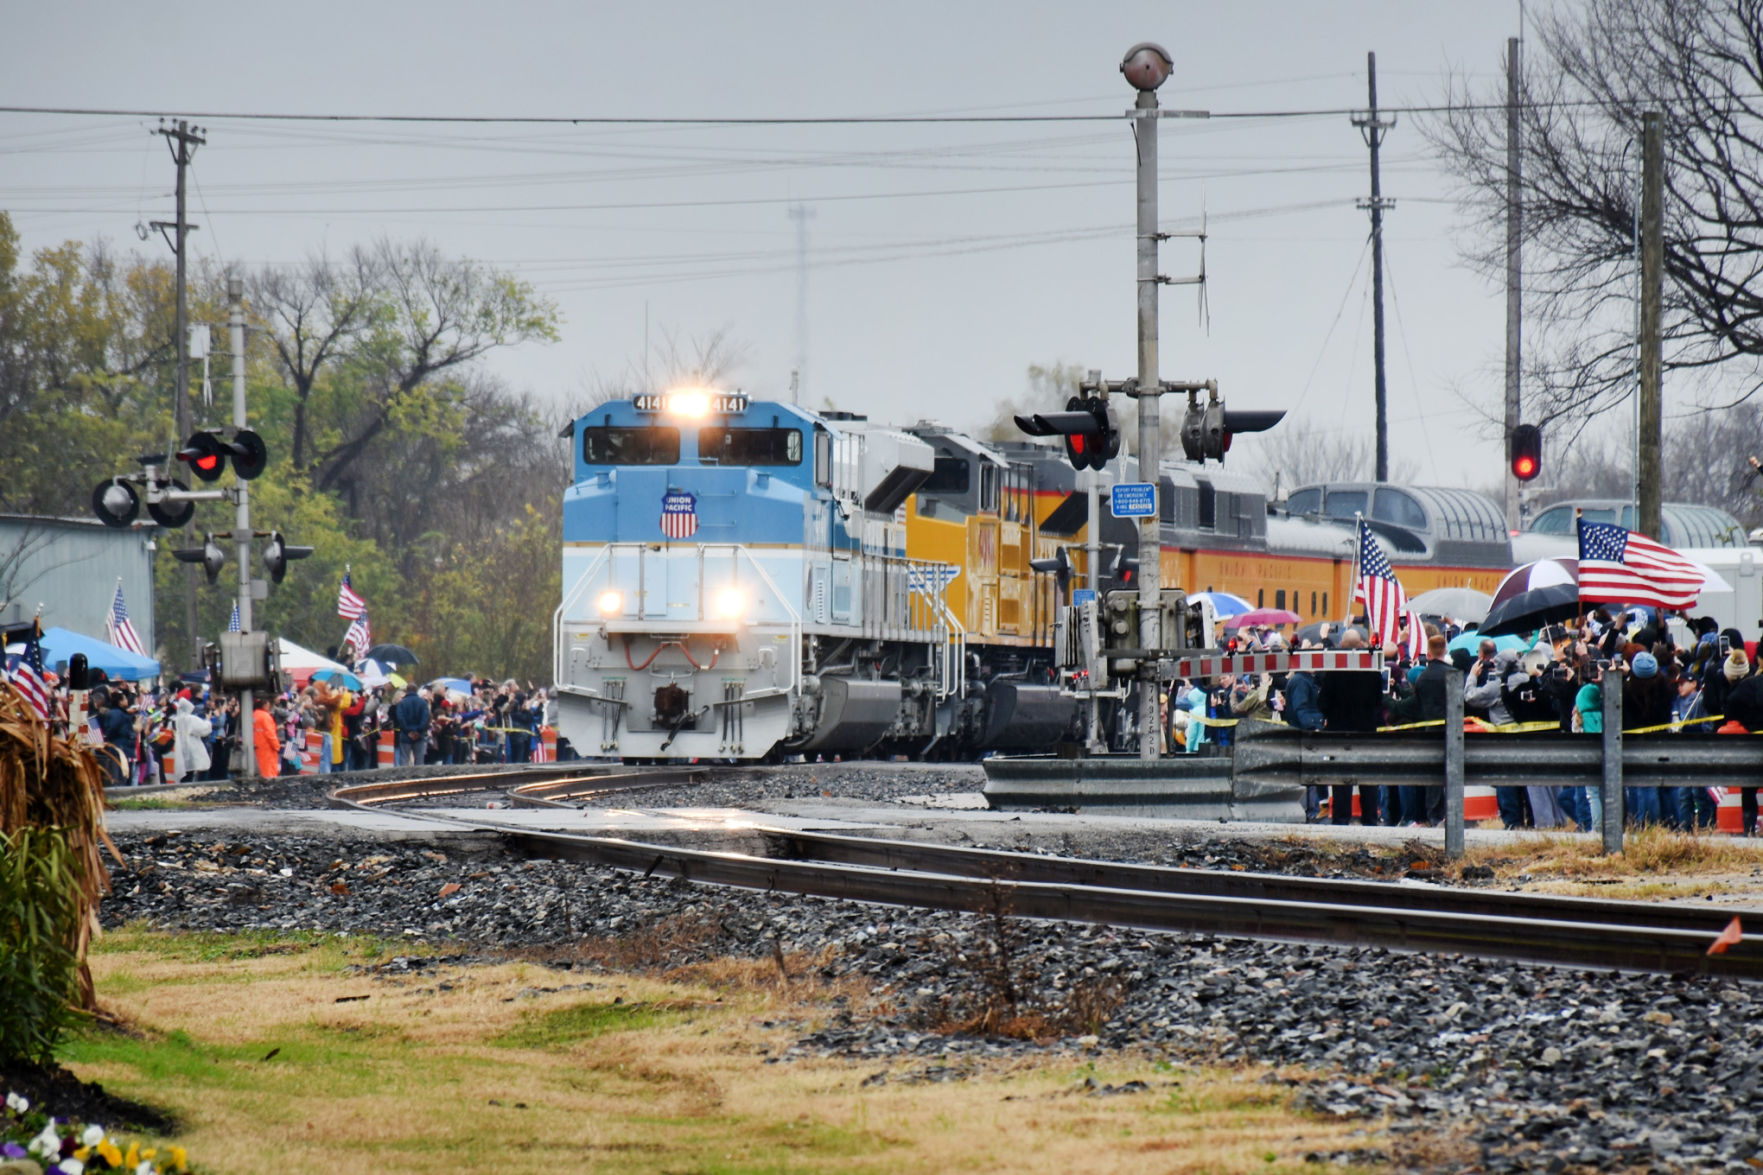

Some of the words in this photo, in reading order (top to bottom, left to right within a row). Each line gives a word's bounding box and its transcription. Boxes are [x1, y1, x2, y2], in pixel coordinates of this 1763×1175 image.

[637, 396, 665, 410] 4141
[713, 397, 744, 412] 4141
[666, 496, 691, 504] UNION
